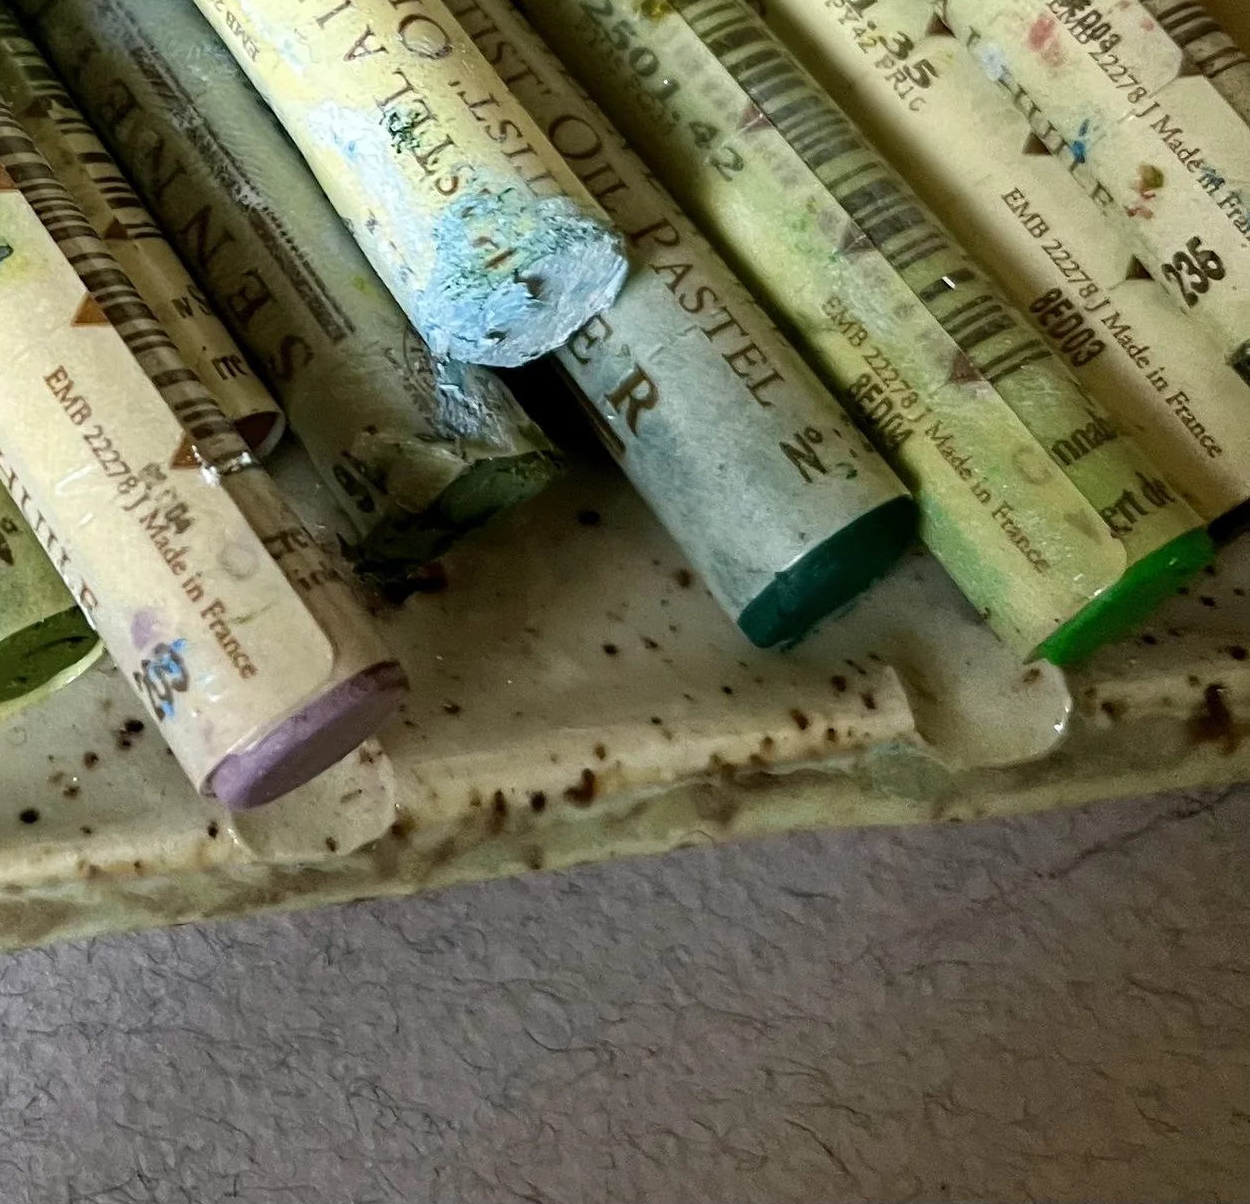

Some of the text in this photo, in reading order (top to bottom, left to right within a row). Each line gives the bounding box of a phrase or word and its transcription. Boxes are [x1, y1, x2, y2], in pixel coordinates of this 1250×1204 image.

[344, 24, 389, 63] A
[1088, 46, 1150, 104] 22278
[1149, 110, 1206, 171] Made
[548, 103, 634, 208] OIL
[626, 223, 790, 409] PASTEL
[1001, 188, 1047, 246] EMB
[1040, 238, 1099, 301] 22278
[1100, 307, 1151, 371] Made
[1145, 365, 1170, 393] in
[1164, 389, 1223, 460] France
[44, 365, 91, 426] EMB
[83, 424, 138, 493] 22278
[139, 504, 190, 577] Made
[181, 572, 205, 603] in
[200, 598, 258, 681] France
[820, 295, 869, 353] EMB
[924, 418, 976, 487] Made
[969, 473, 993, 507] in
[991, 500, 1048, 575] France
